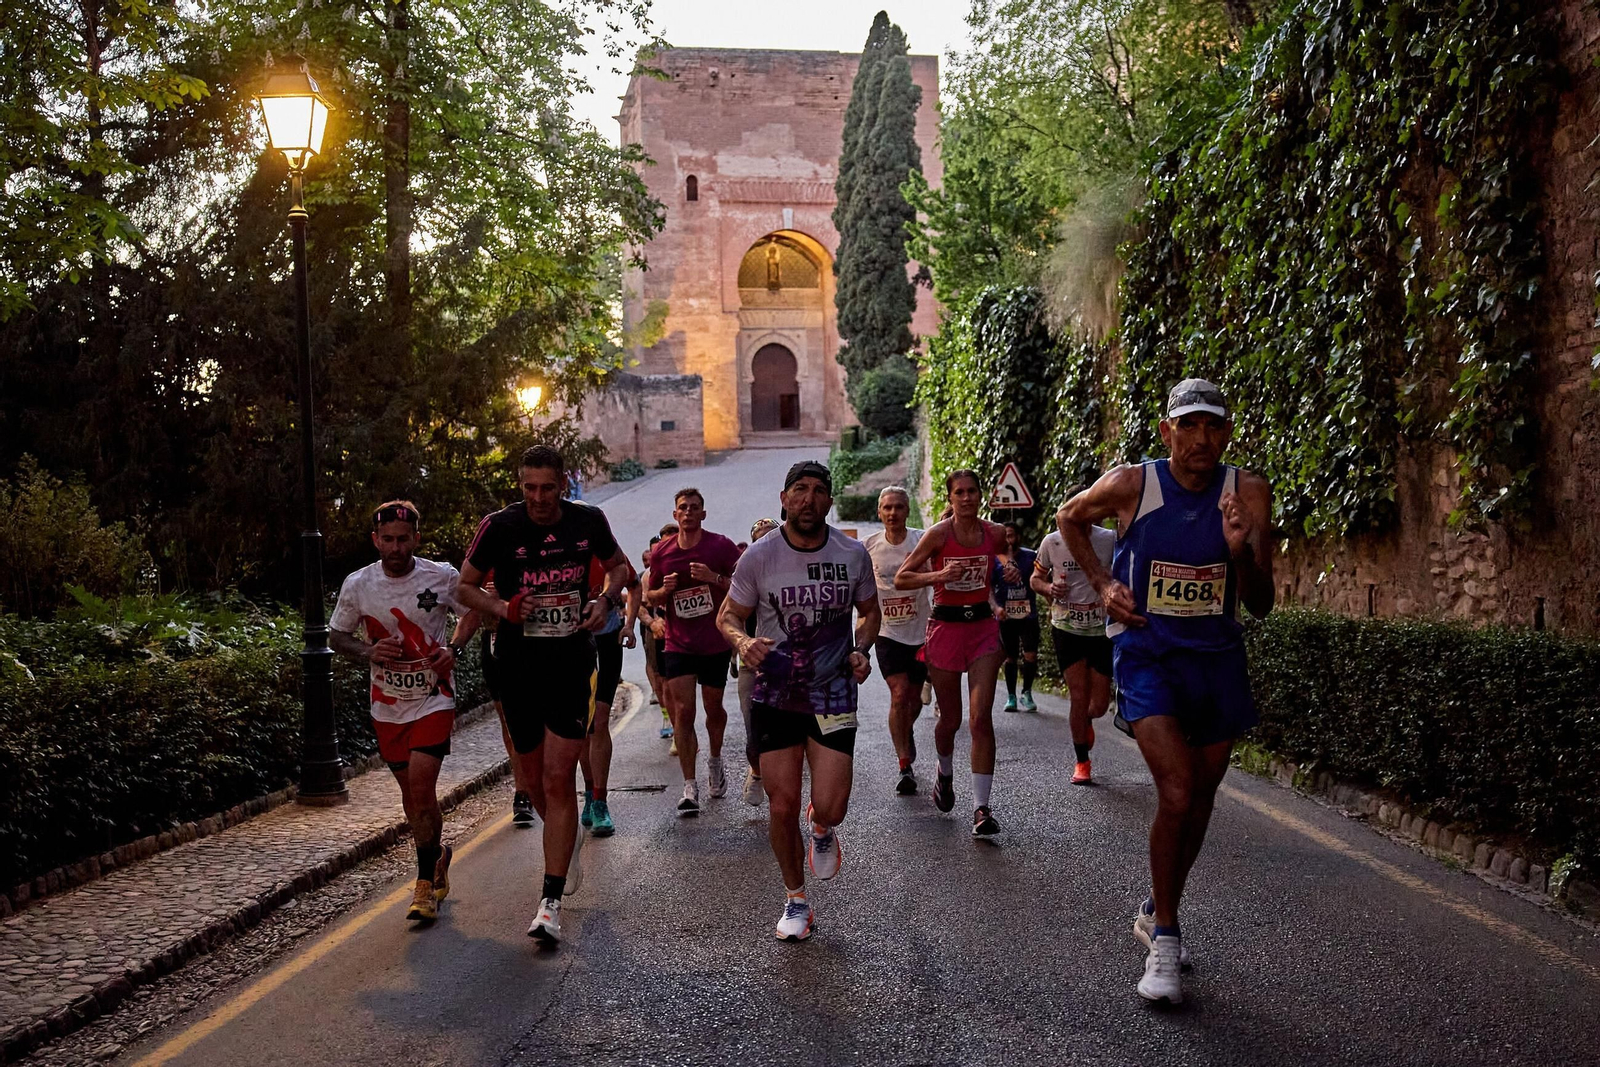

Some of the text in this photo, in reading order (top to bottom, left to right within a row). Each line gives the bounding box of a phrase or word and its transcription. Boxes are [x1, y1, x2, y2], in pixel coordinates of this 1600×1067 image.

[522, 565, 585, 586] MADRID
[808, 563, 848, 580] THE
[964, 567, 981, 581] 27
[1154, 564, 1165, 577] 41
[783, 584, 850, 605] LAST
[1152, 579, 1213, 602] 1468
[676, 595, 705, 611] 1202
[884, 604, 912, 617] 4072
[1069, 610, 1097, 622] 2811
[384, 671, 425, 688] 3309
